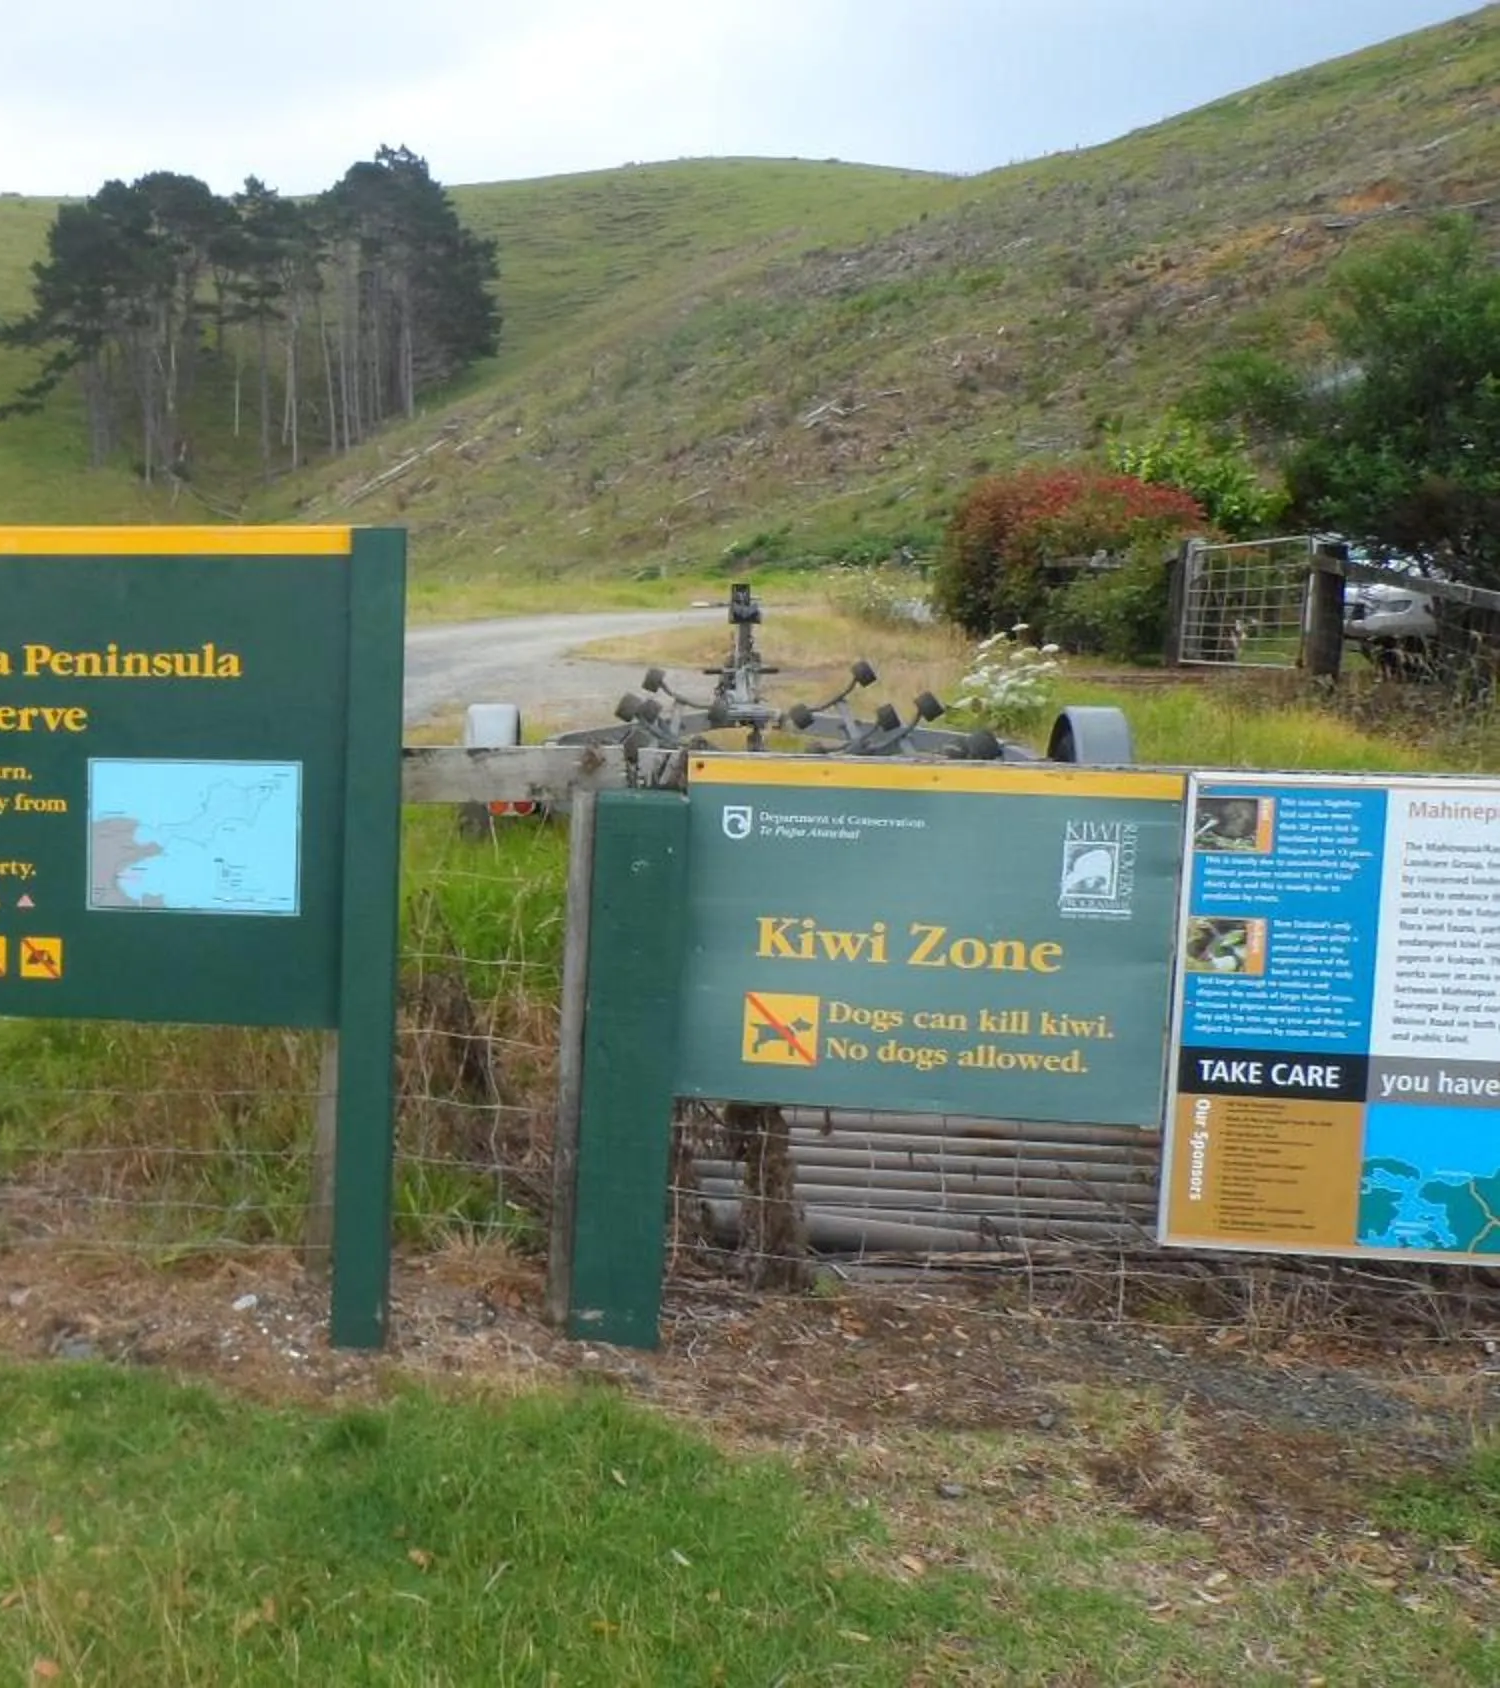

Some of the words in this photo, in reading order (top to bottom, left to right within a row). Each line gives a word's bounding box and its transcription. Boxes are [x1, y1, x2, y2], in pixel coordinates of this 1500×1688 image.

[23, 642, 242, 678] Peninsula
[14, 793, 67, 813] from
[760, 811, 829, 826] Department
[831, 813, 843, 826] of
[847, 814, 926, 829] Conservation
[1065, 820, 1120, 841] KIWI
[756, 917, 888, 964] Kiwi
[907, 922, 1063, 973] Zone
[827, 1001, 903, 1032] Dogs
[913, 1011, 968, 1031] can
[979, 1008, 1029, 1035] kill
[1040, 1011, 1114, 1039] kiwi.
[825, 1038, 868, 1060] No
[877, 1039, 947, 1071] dogs
[957, 1045, 1088, 1073] allowed.
[1197, 1060, 1263, 1084] TAKE
[1271, 1063, 1341, 1089] CARE
[1380, 1073, 1428, 1097] you
[1438, 1070, 1500, 1096] have
[1195, 1099, 1211, 1130] Our
[1188, 1131, 1209, 1201] Sponsors
